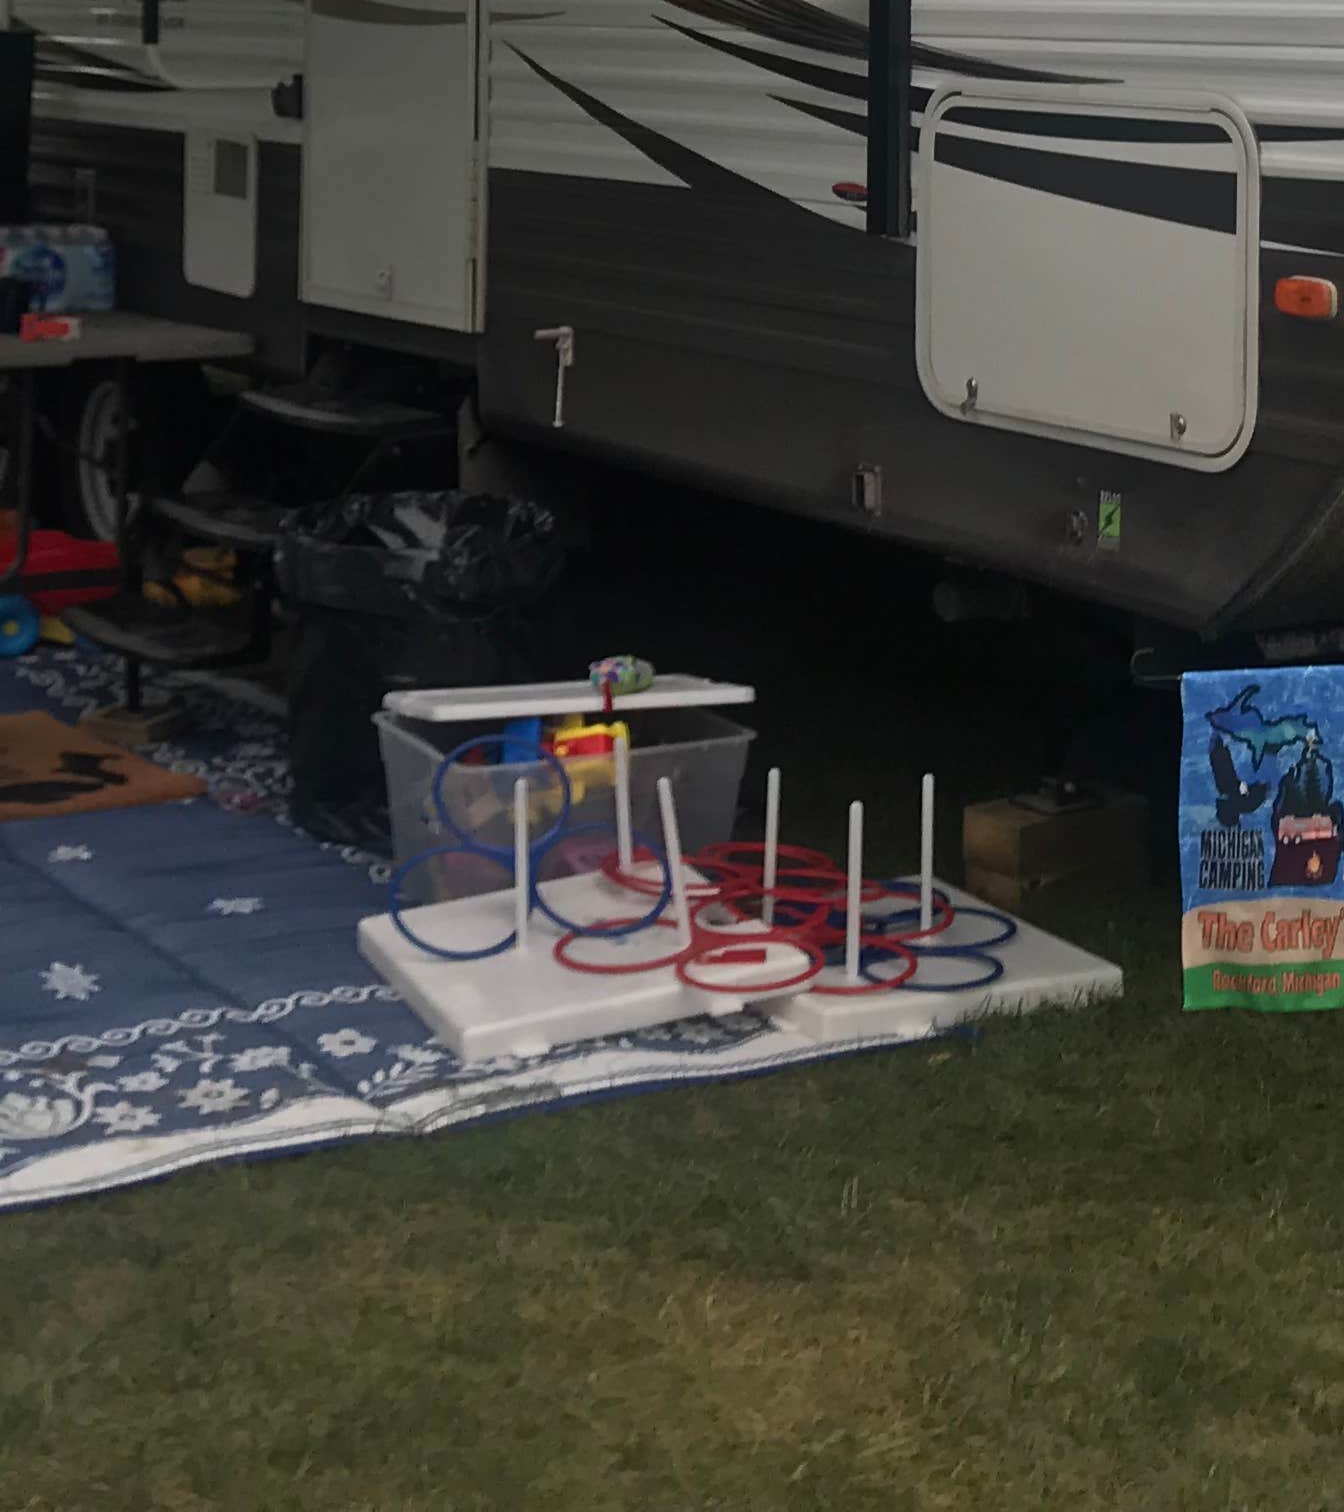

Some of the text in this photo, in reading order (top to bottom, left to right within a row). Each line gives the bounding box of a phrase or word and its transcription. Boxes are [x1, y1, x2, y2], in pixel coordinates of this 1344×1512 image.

[1200, 828, 1265, 859] MICHIGAN
[1199, 859, 1265, 890] CAMPING
[1198, 911, 1255, 953] The
